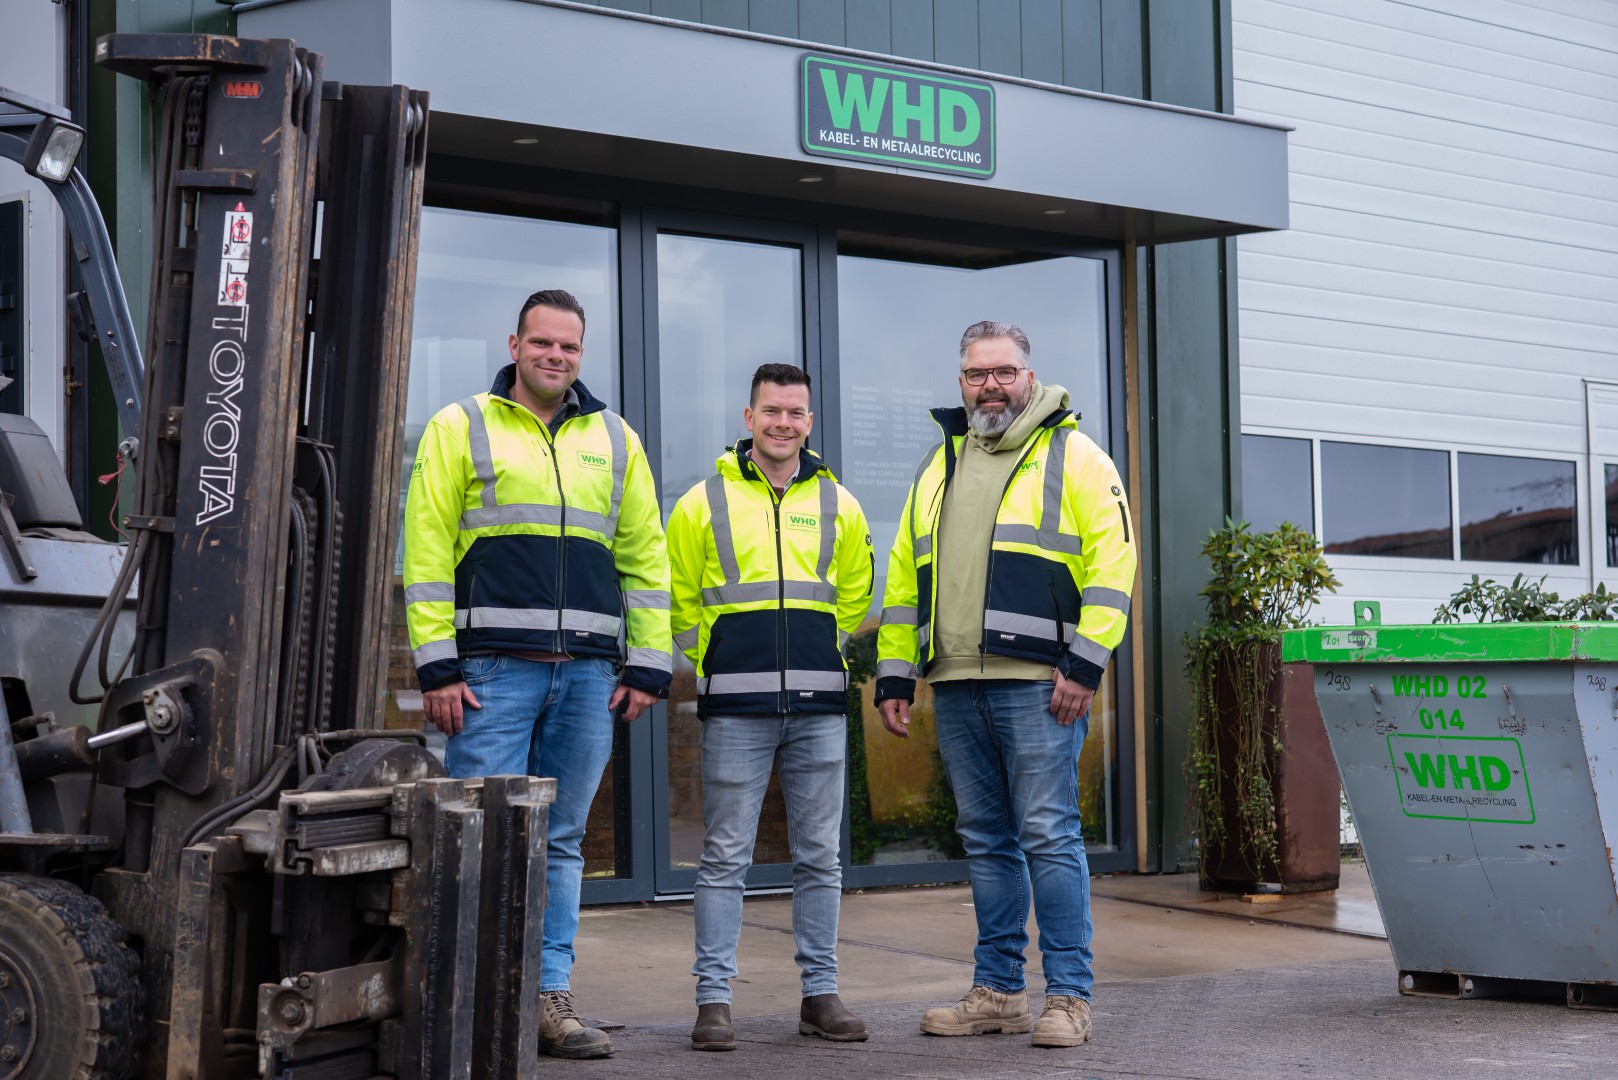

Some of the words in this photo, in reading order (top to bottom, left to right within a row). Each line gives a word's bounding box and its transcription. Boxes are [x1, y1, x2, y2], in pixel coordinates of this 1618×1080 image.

[819, 68, 981, 147] WHD
[819, 129, 860, 146] KABEL-
[863, 136, 878, 149] EN
[881, 139, 982, 164] METAALRECYCLING
[196, 304, 250, 526] TOYOTA
[581, 454, 607, 466] WHD
[789, 515, 817, 527] WHD
[1324, 670, 1352, 692] 298
[1392, 674, 1449, 698] WHD
[1457, 675, 1487, 699] 02
[1586, 674, 1607, 692] 298
[1419, 708, 1465, 731] 014
[1403, 752, 1511, 792] WHD
